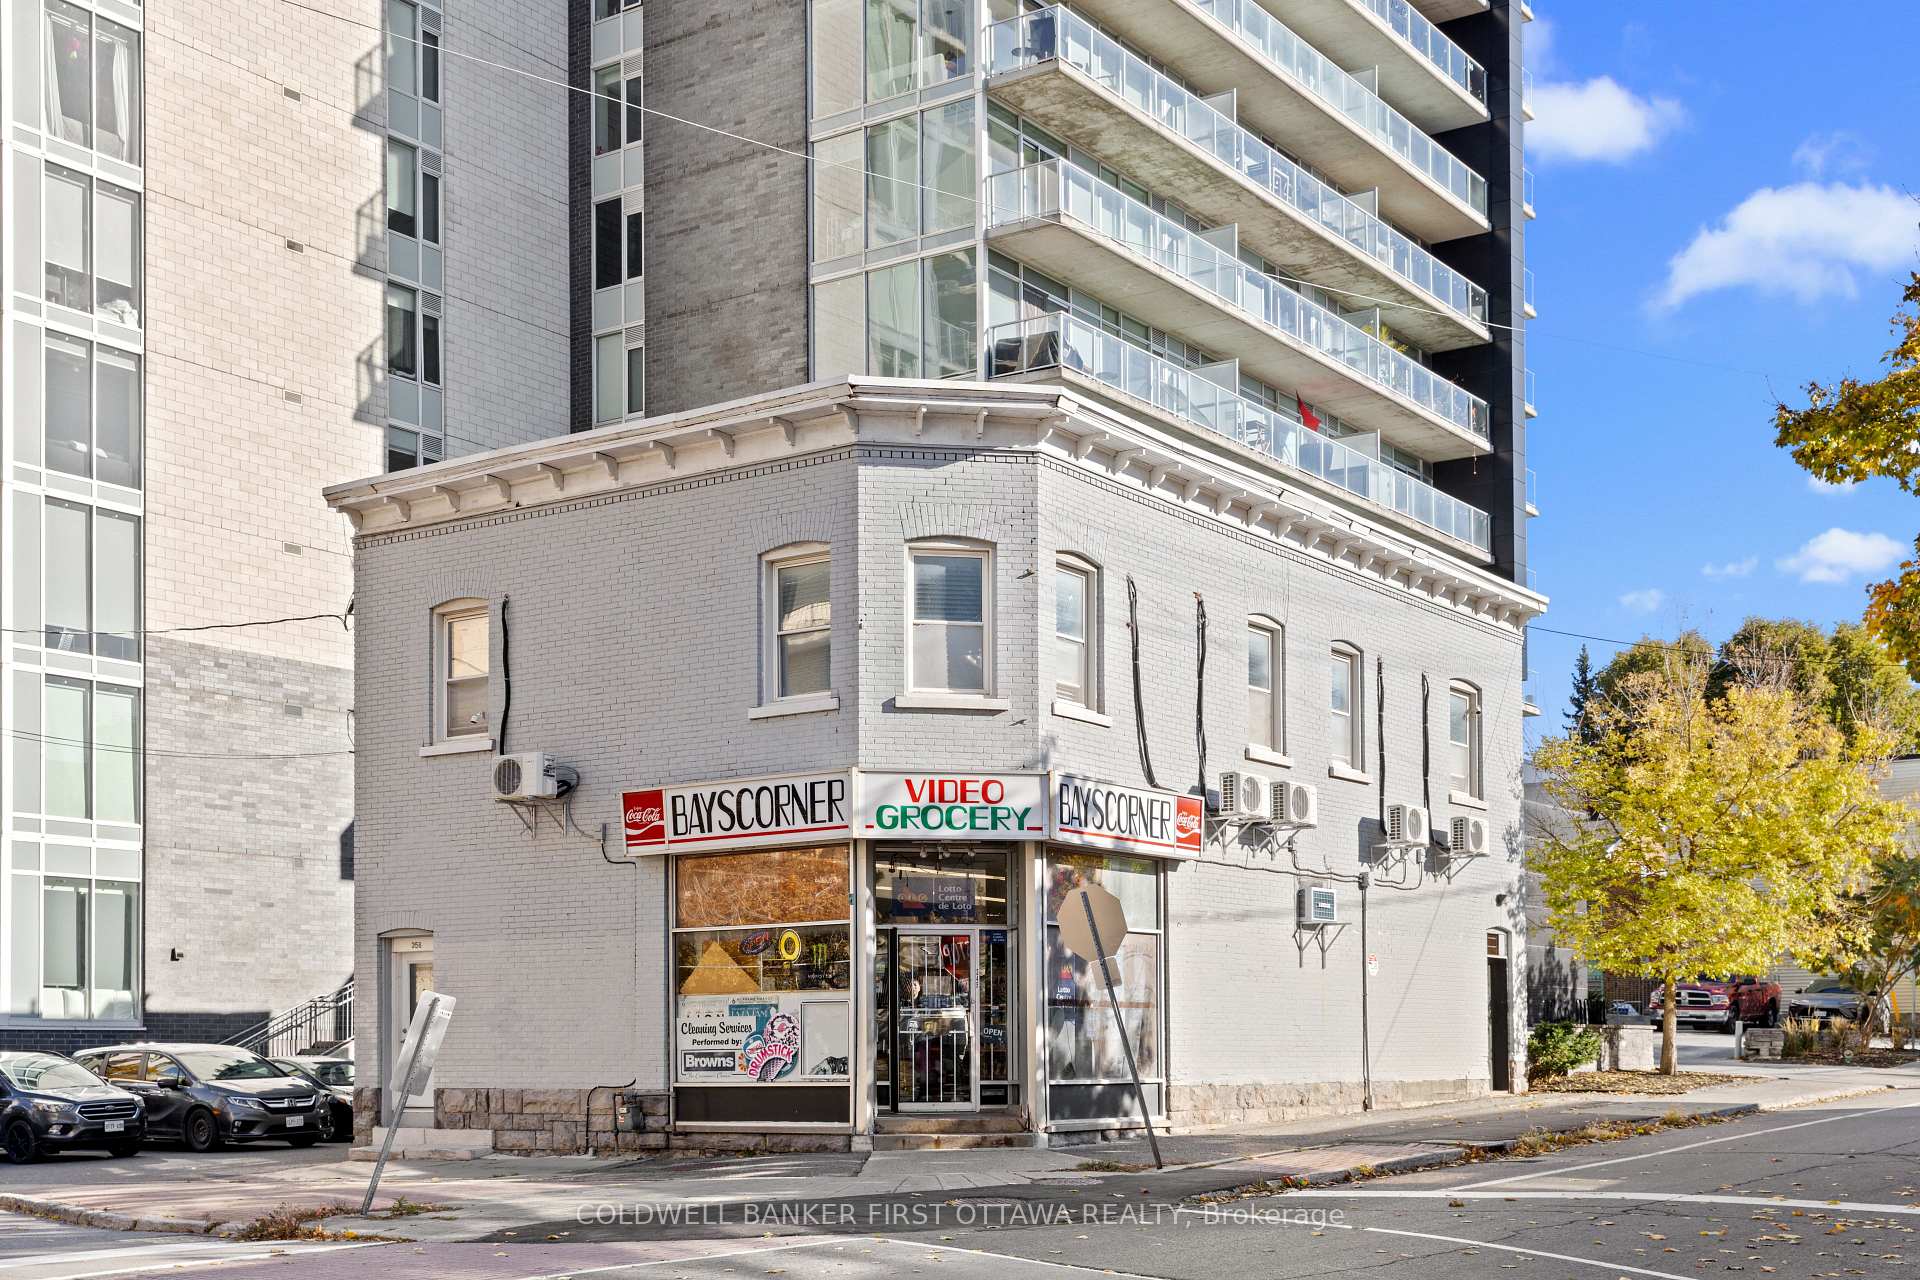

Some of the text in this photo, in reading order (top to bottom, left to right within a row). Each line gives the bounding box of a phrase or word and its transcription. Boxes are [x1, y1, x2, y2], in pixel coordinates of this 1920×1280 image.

[904, 778, 1005, 805] VIDEO
[671, 779, 845, 837] BAYSCORNER
[1059, 783, 1171, 841] BAYSCORNER
[875, 804, 1032, 832] GROCERY
[938, 885, 961, 893] Lotto
[938, 893, 968, 902] Centre
[938, 902, 972, 910] de Loto
[681, 1021, 753, 1037] Cleaning Services
[983, 1027, 1003, 1037] OPEN
[692, 1038, 742, 1047] Performed by:
[685, 1054, 735, 1068] Browns
[748, 1043, 794, 1077] DRUMSTICK
